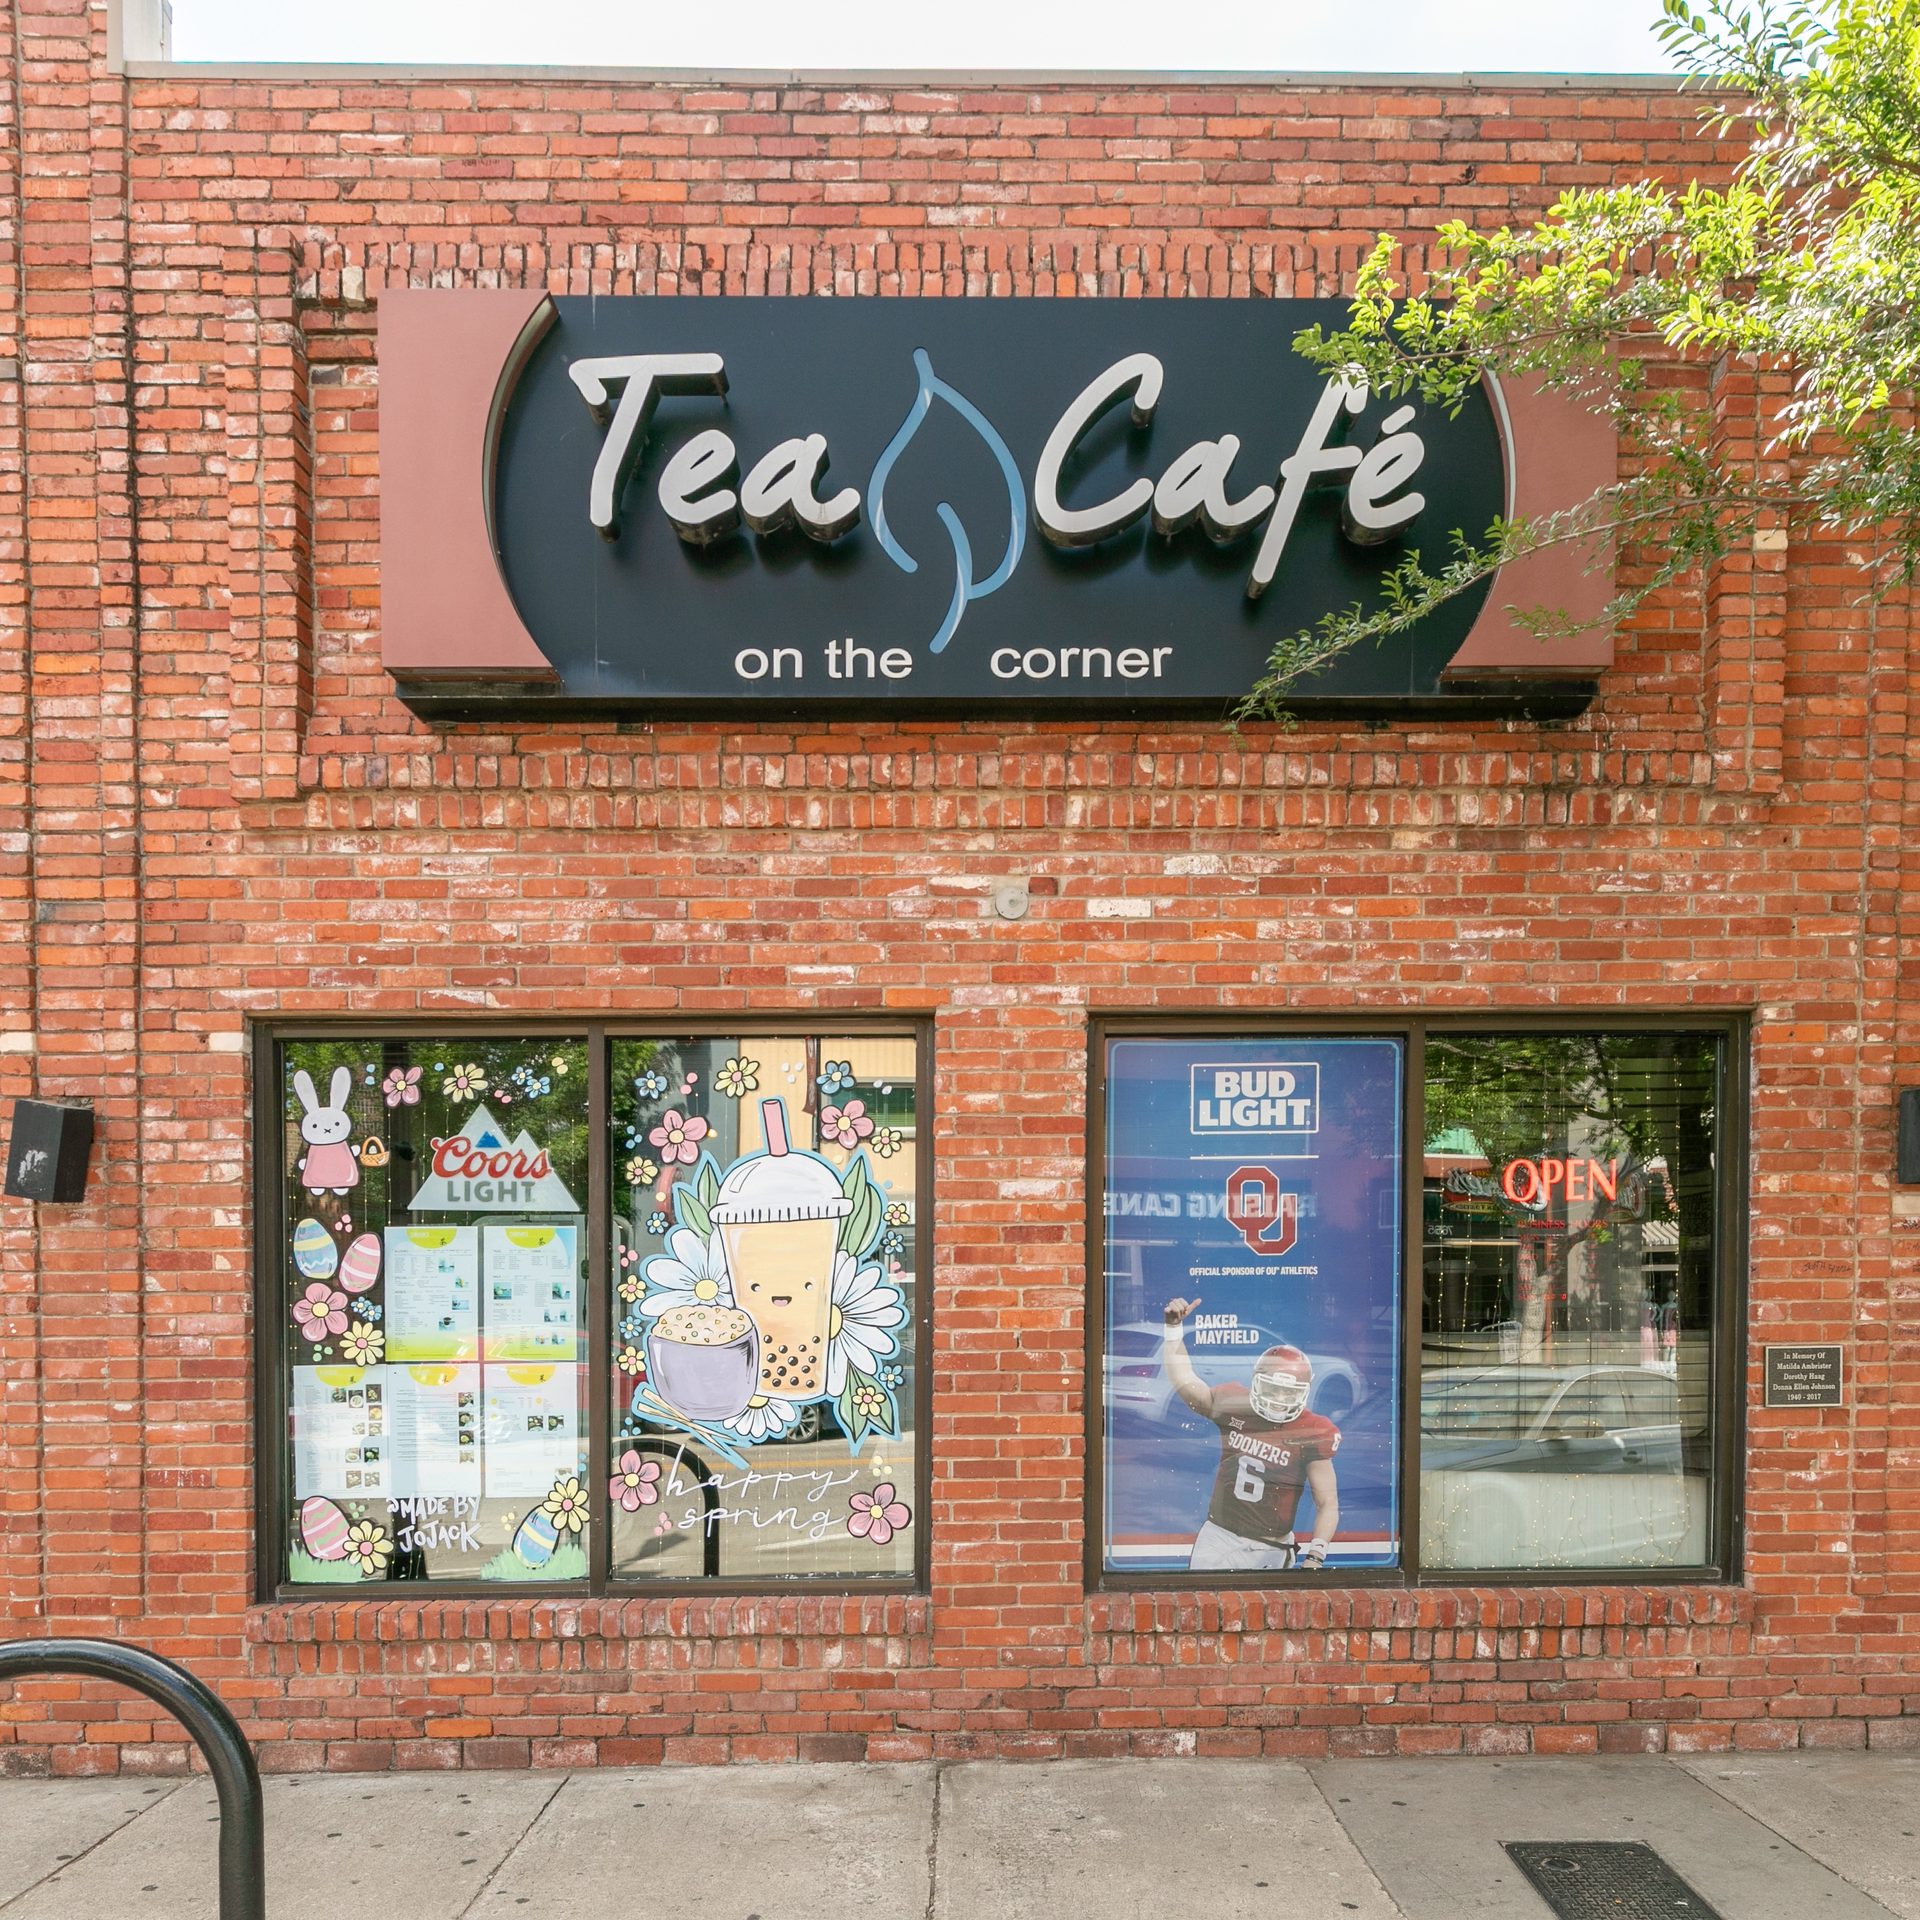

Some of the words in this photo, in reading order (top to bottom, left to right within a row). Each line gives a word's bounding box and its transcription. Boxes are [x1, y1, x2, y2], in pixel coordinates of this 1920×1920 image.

[568, 351, 862, 538] Tea
[1035, 351, 1427, 597] Café
[735, 647, 804, 679] on
[824, 638, 913, 679] the
[990, 647, 1173, 679] corner
[1214, 1071, 1296, 1098] BUD
[1198, 1099, 1310, 1127] LIGHT
[430, 1136, 553, 1180] Coors
[446, 1180, 536, 1203] LIGHT
[1502, 1157, 1618, 1203] OPEN
[1189, 1267, 1221, 1276] OFFICIAL
[1221, 1266, 1255, 1276] SPONSOR
[1255, 1266, 1265, 1275] OF
[1280, 1266, 1318, 1275] ATHLETICS
[1195, 1314, 1238, 1329] BAKER
[1195, 1330, 1260, 1345] MAYFIELD
[1792, 1352, 1816, 1360] Memory
[1772, 1383, 1793, 1391] Donna
[1793, 1383, 1810, 1391] Ellen
[1783, 1373, 1808, 1381] Dorothy
[1227, 1430, 1291, 1467] SOONERS
[665, 1443, 860, 1503] happy
[1233, 1455, 1266, 1503] 6
[453, 1494, 481, 1522] BY
[677, 1505, 845, 1541] spring
